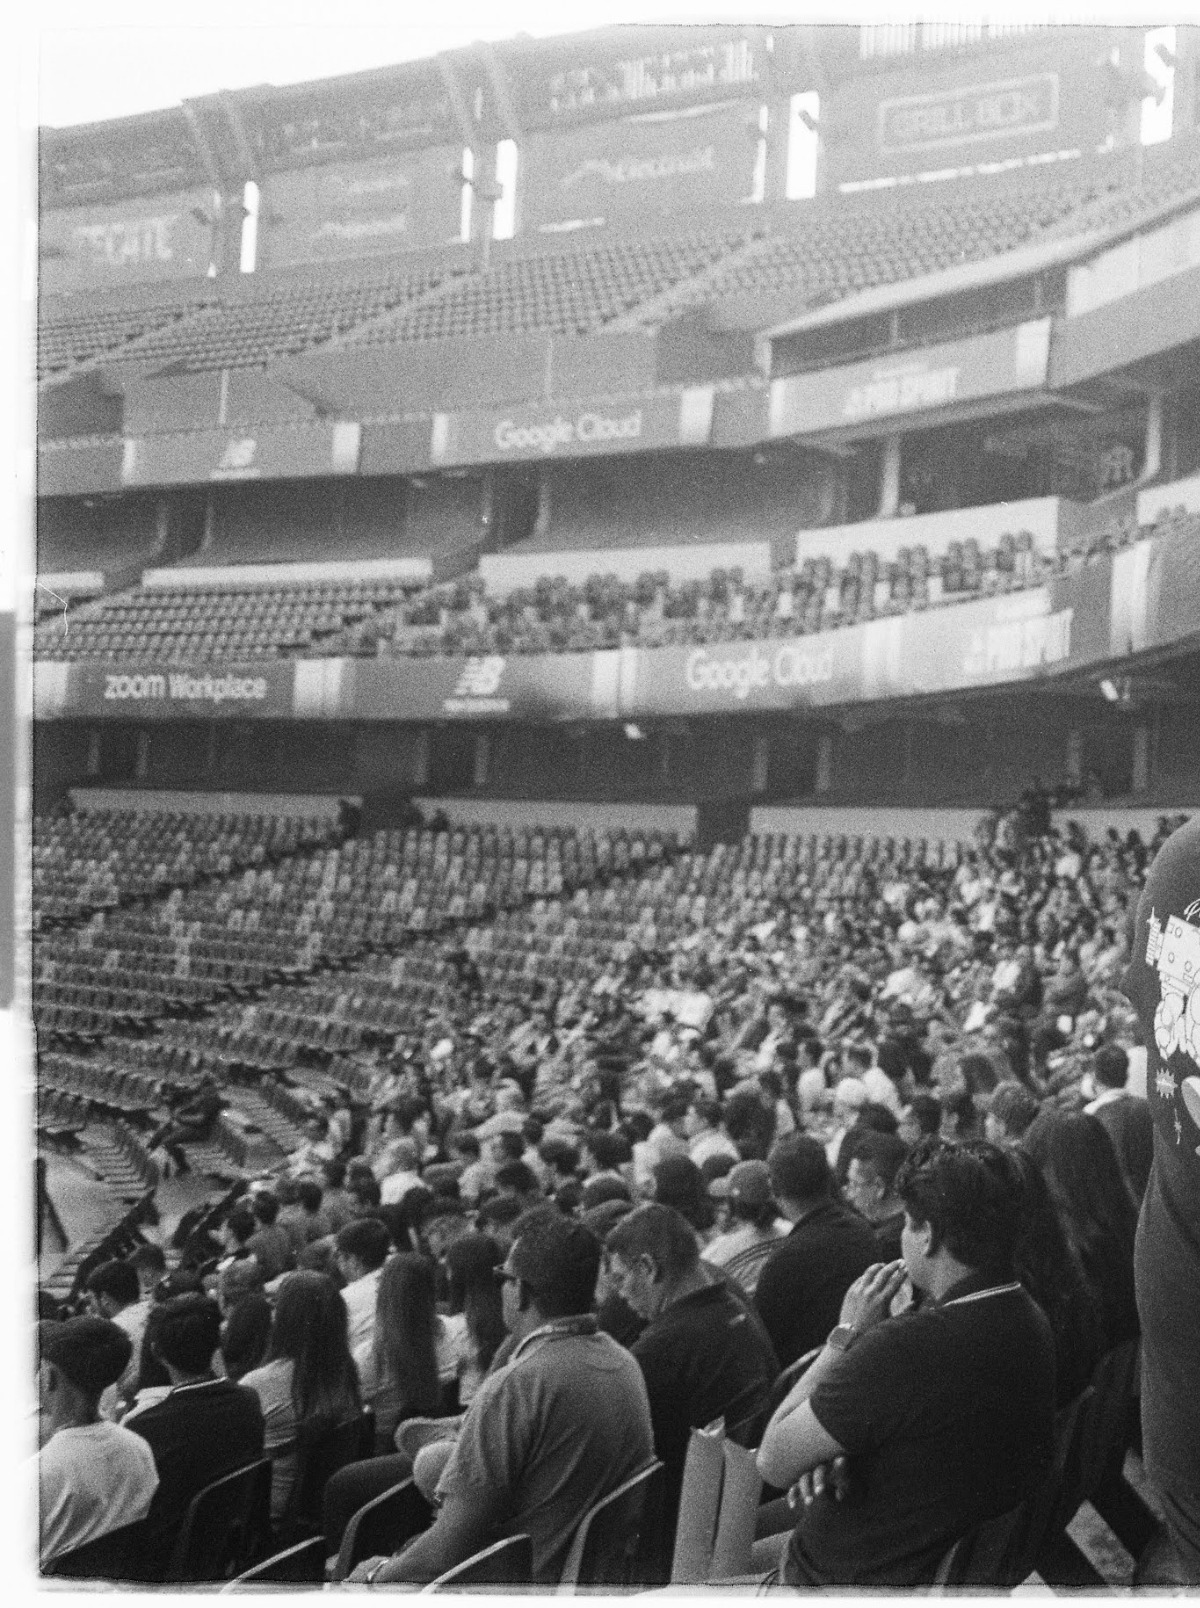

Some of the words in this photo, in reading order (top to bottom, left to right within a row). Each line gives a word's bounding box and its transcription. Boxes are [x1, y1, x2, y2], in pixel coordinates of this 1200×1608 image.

[495, 416, 573, 453] Google
[576, 410, 643, 441] Cloud
[104, 674, 166, 699] zoom
[168, 672, 267, 703] Workplace
[687, 649, 770, 699] Google
